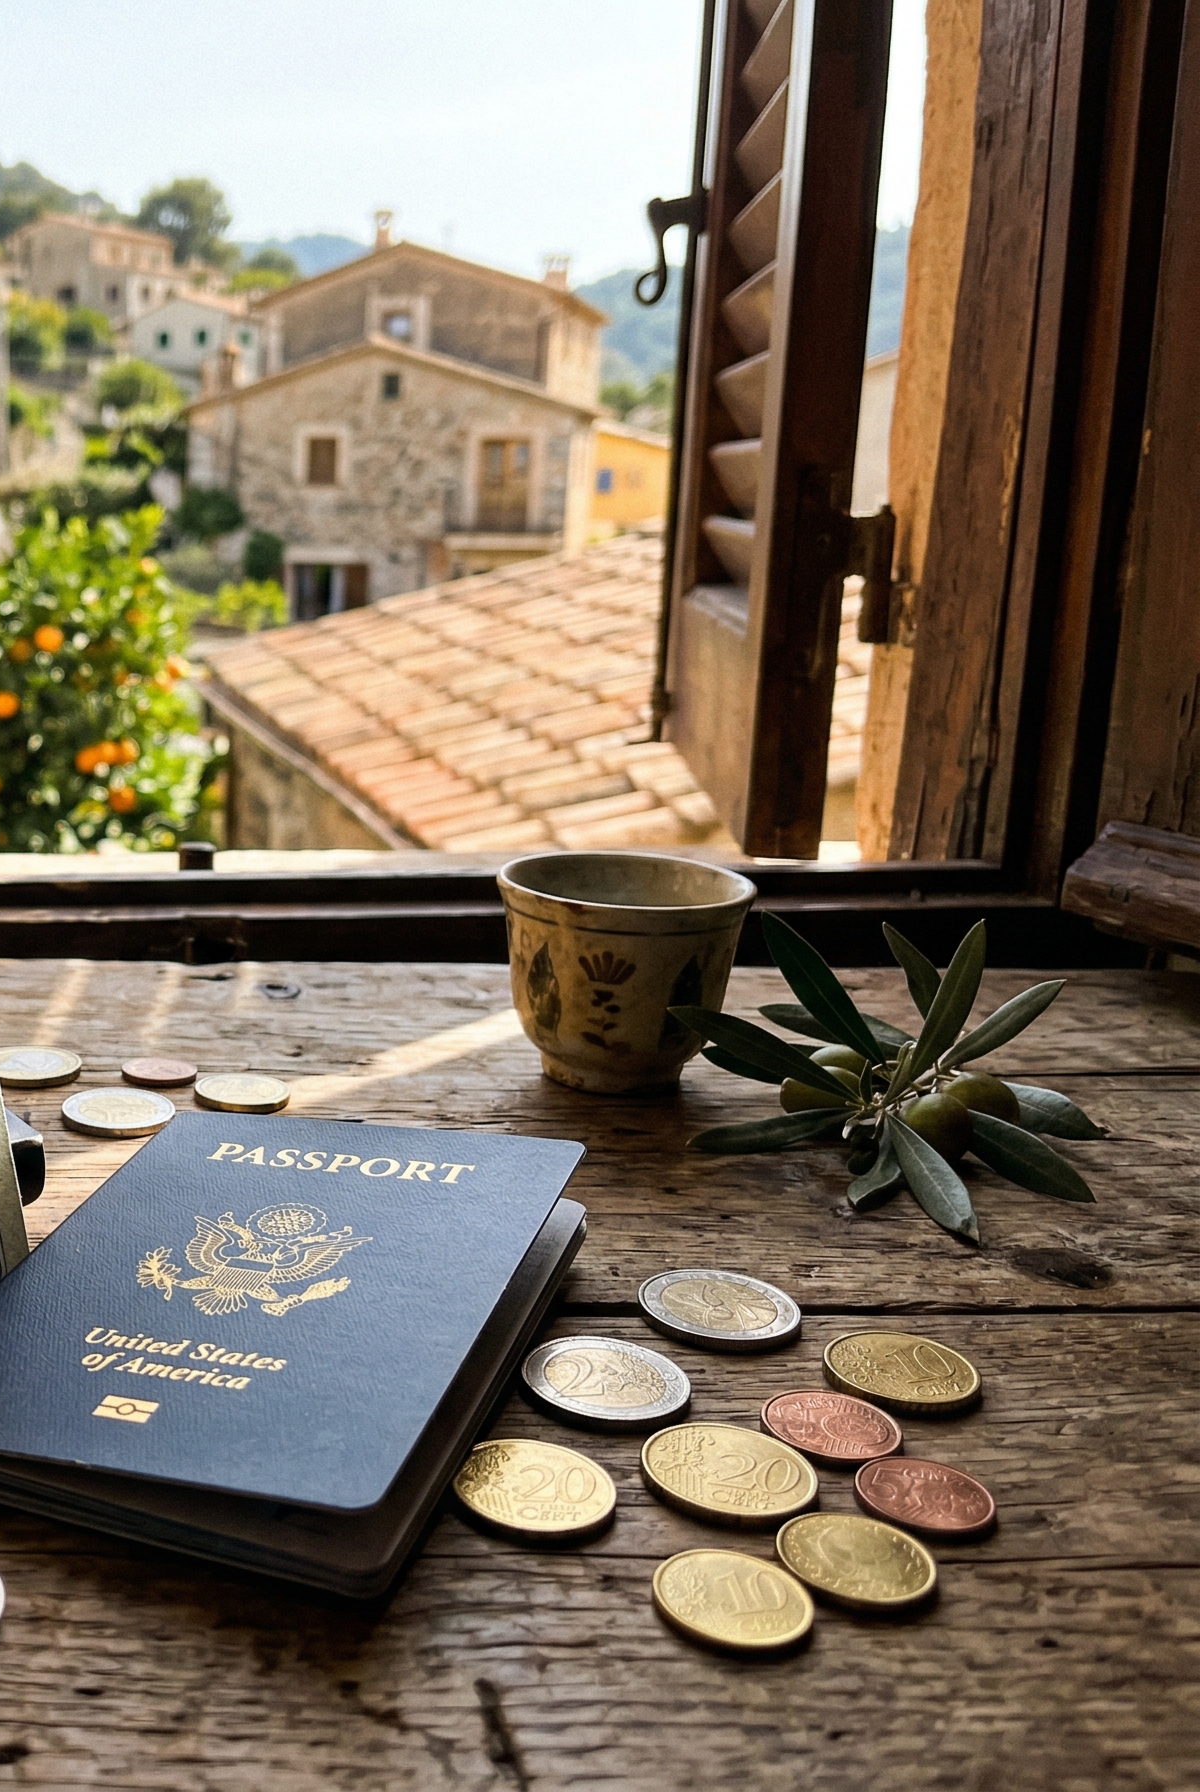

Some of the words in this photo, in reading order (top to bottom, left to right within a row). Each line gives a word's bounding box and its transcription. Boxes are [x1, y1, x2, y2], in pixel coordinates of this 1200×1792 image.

[206, 1142, 476, 1184] PASSPORT
[84, 1327, 192, 1357] United
[189, 1343, 287, 1371] States
[884, 1344, 957, 1384] 10
[81, 1352, 126, 1372] of
[114, 1356, 251, 1390] America
[547, 1354, 605, 1398] 2
[512, 1464, 597, 1504] 20
[707, 1453, 801, 1494] 20
[866, 1468, 904, 1500] 5
[714, 1570, 789, 1617] 10
